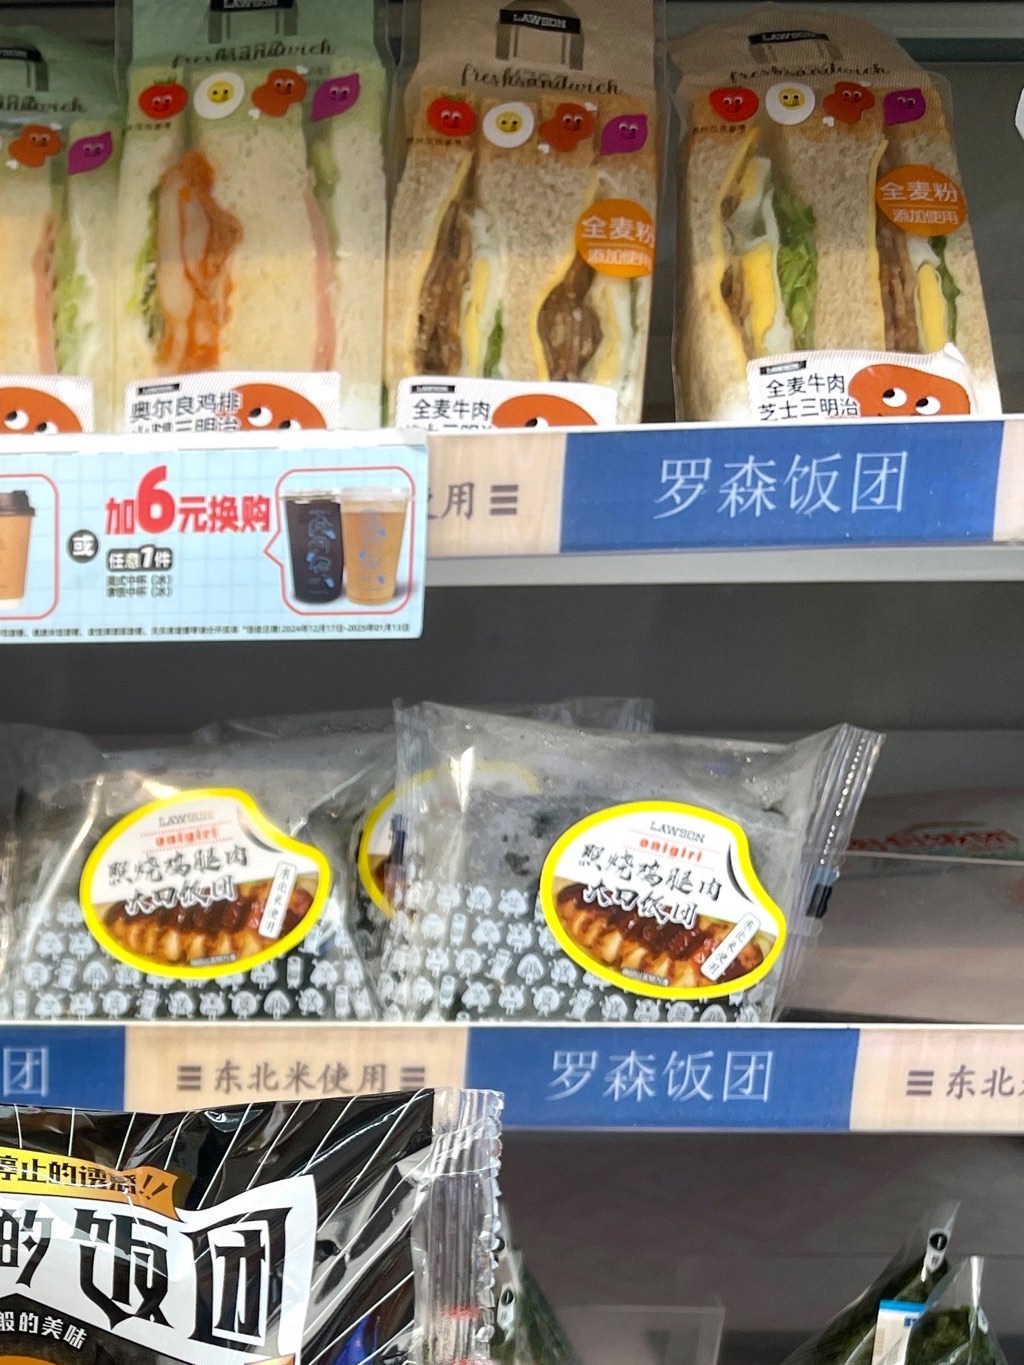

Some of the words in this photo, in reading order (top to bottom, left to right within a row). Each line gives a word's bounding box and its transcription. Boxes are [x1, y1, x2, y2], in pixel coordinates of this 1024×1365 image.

[512, 12, 568, 29] LAWSON
[761, 31, 817, 43] LAWSON
[878, 178, 960, 206] 全麦粉
[581, 212, 655, 245] 全麦粉
[892, 208, 961, 225] 添加使用
[766, 373, 846, 398] 全麦牛肉
[132, 392, 240, 422] 奥尔良鸡排
[413, 398, 490, 422] 全麦牛肉
[758, 397, 860, 422] 芝士三明治
[652, 450, 910, 521] 罗森饭团
[105, 466, 271, 537] 加6元换购
[71, 535, 95, 558] 或
[107, 546, 173, 570] 任意1件
[650, 820, 706, 844] LAWSON
[639, 838, 704, 862] onigiri
[108, 845, 249, 887] 照烧鸡腿肉
[578, 844, 723, 902] 照烧鸡腿肉
[582, 877, 699, 930] 大口饭团
[213, 1060, 388, 1095] 东北米使用
[546, 1049, 775, 1104] 罗森饭团
[945, 1064, 1024, 1100] 东北
